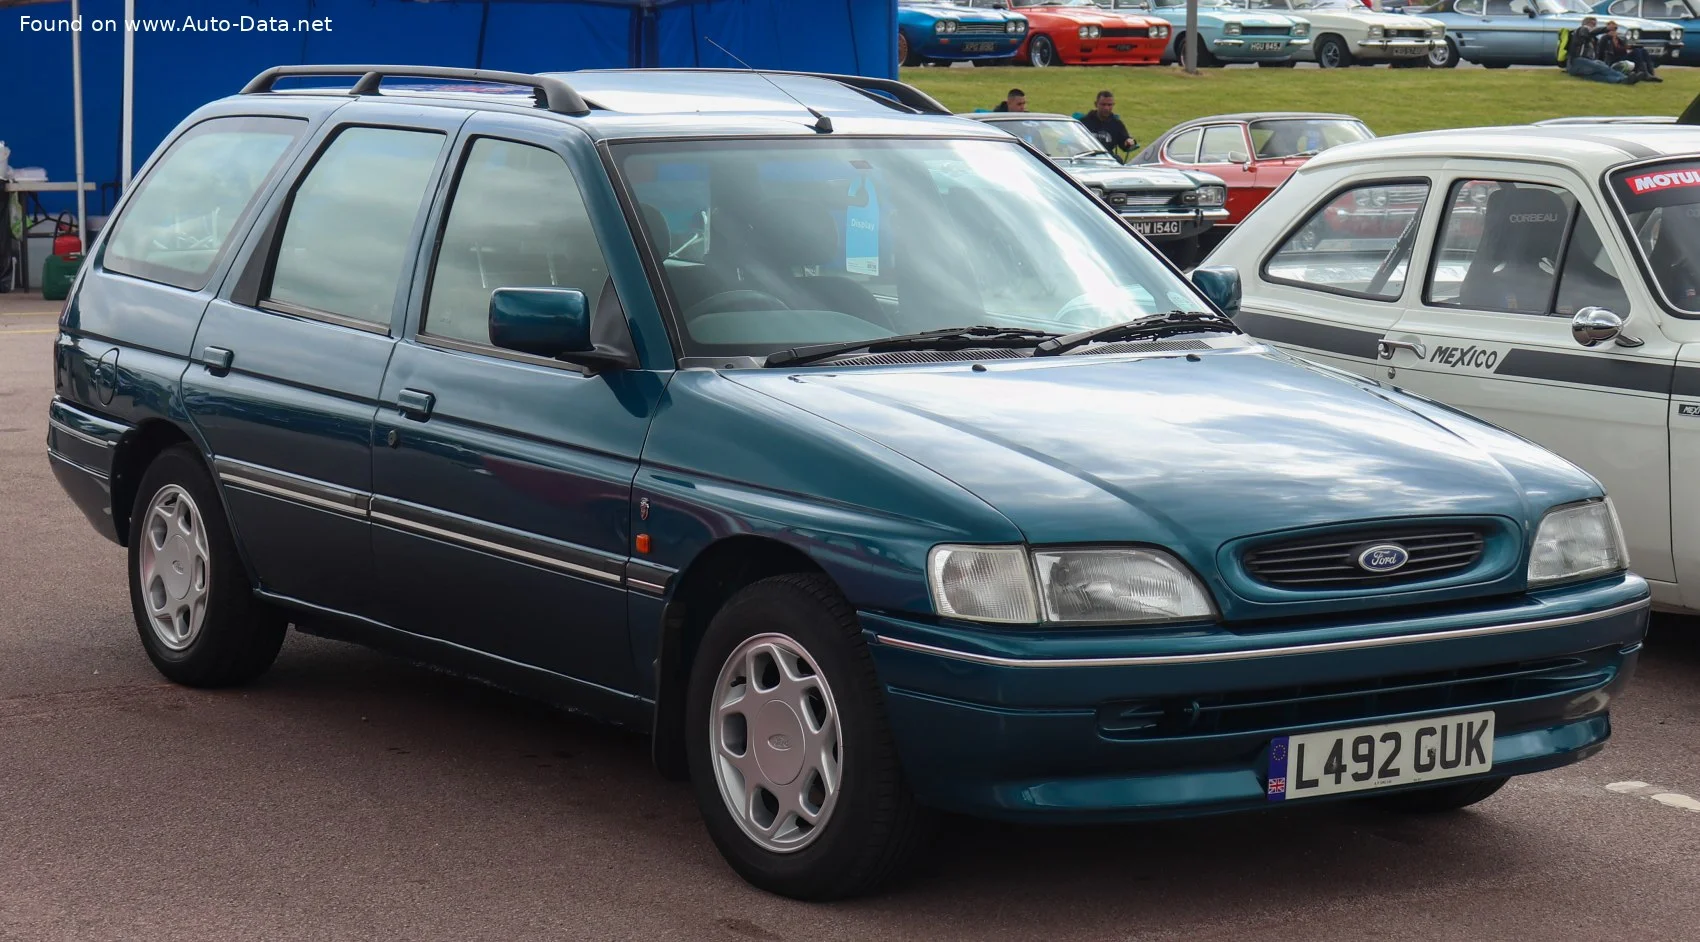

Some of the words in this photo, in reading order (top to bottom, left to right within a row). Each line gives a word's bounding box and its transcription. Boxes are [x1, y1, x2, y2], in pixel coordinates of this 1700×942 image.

[851, 218, 875, 231] Display
[1509, 212, 1558, 223] CORBEAU
[1153, 221, 1178, 233] 154G
[1430, 345, 1498, 369] MEXICO
[1371, 550, 1397, 566] Ford
[1295, 731, 1402, 790] L492
[1413, 719, 1489, 774] GUK
